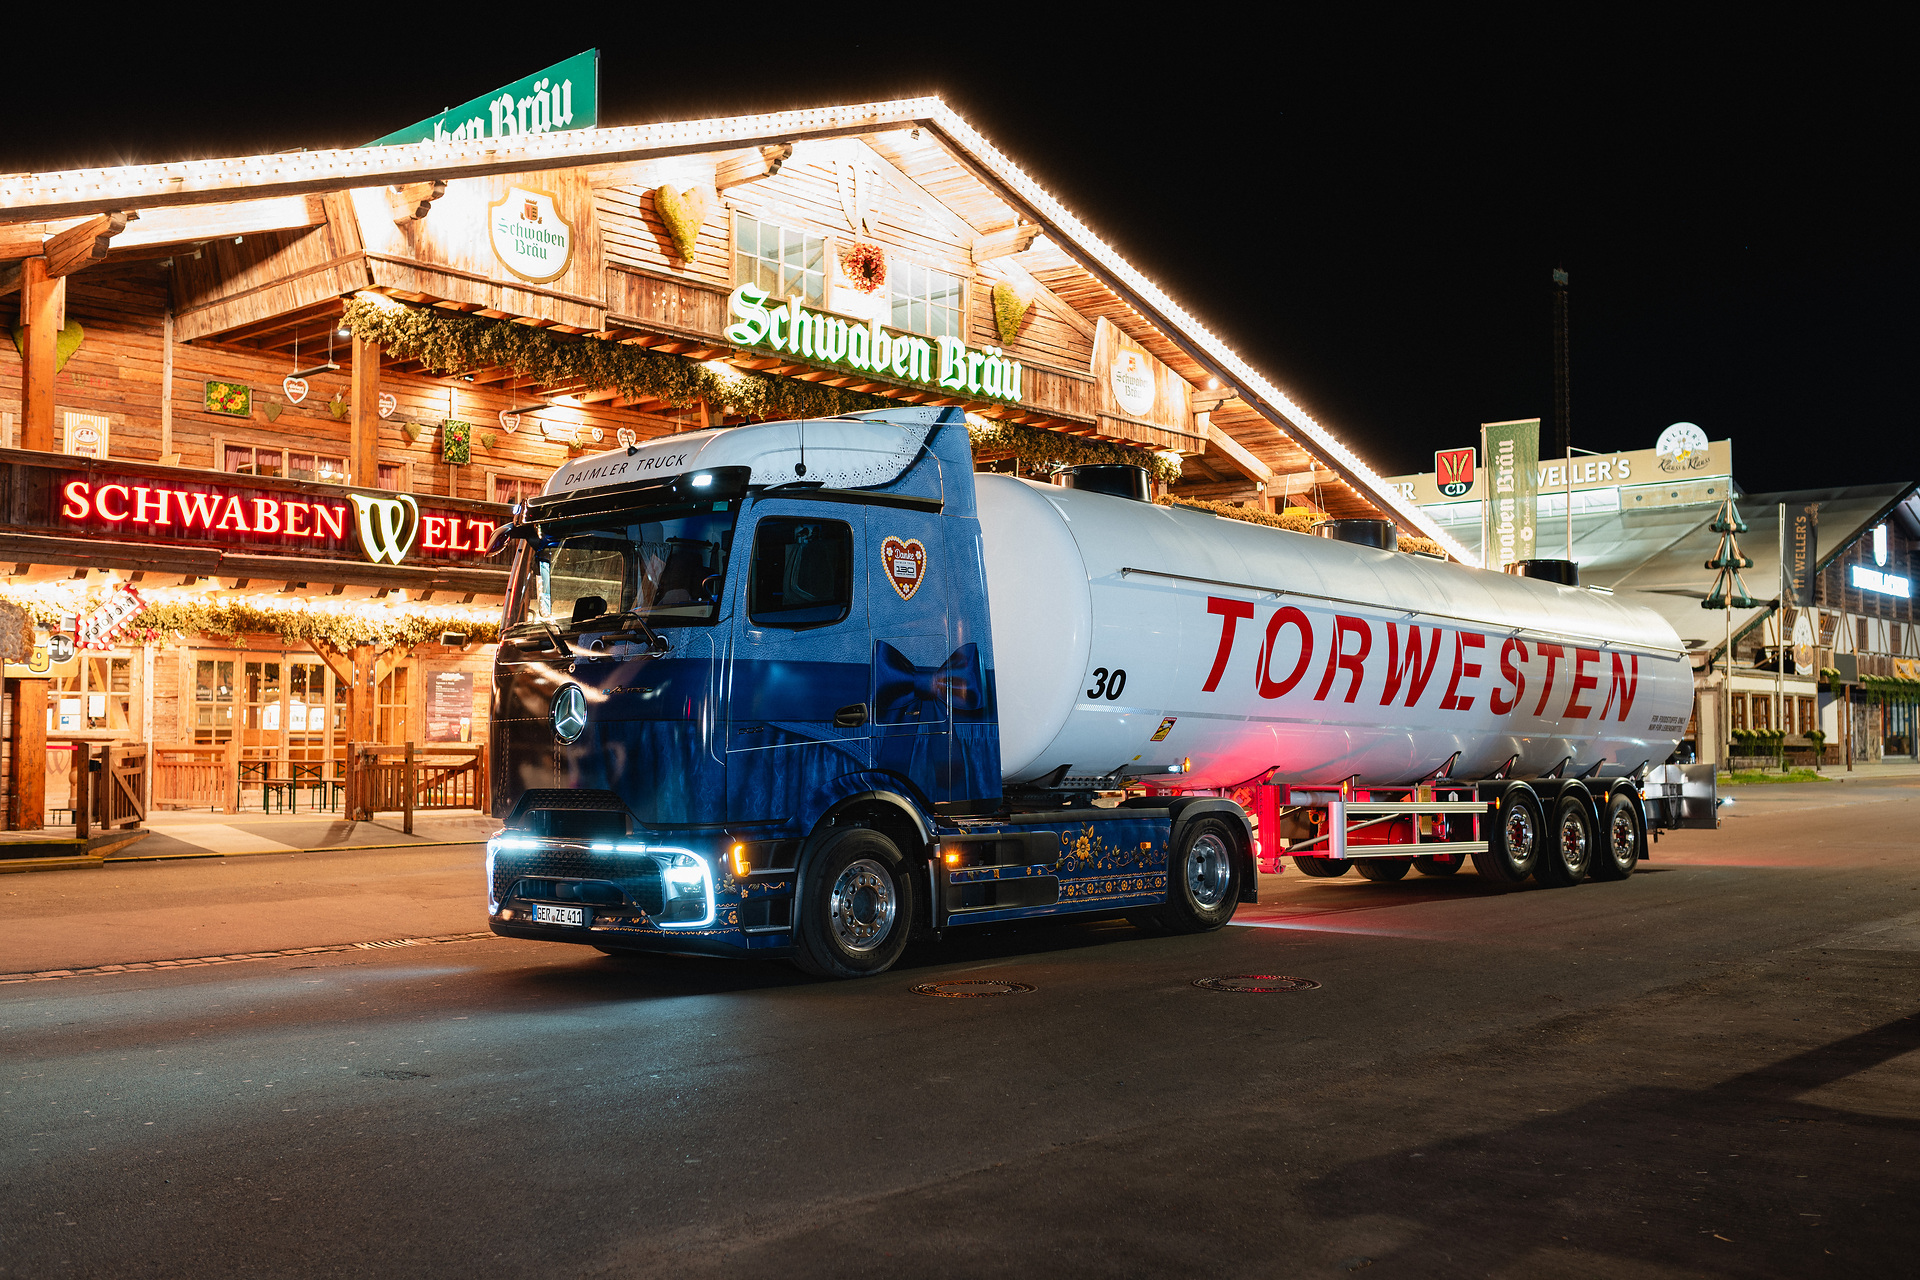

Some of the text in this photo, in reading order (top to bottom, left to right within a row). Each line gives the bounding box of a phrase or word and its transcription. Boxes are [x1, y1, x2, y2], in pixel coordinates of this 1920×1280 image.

[489, 78, 573, 137] Bräu
[498, 218, 565, 248] Schwaben
[515, 239, 547, 260] Bräu
[725, 282, 1022, 402] Schwaben Bräu
[565, 453, 688, 486] DAIMLER TRUCK
[1496, 439, 1515, 494] Bräu
[1445, 483, 1466, 495] CD
[63, 481, 347, 539] SCHWABEN
[895, 548, 915, 560] Danke
[1795, 516, 1807, 572] WELLER'S
[1201, 596, 1639, 723] TORWESTEN
[1087, 667, 1127, 700] 30
[537, 907, 582, 924] GER ZE 411
